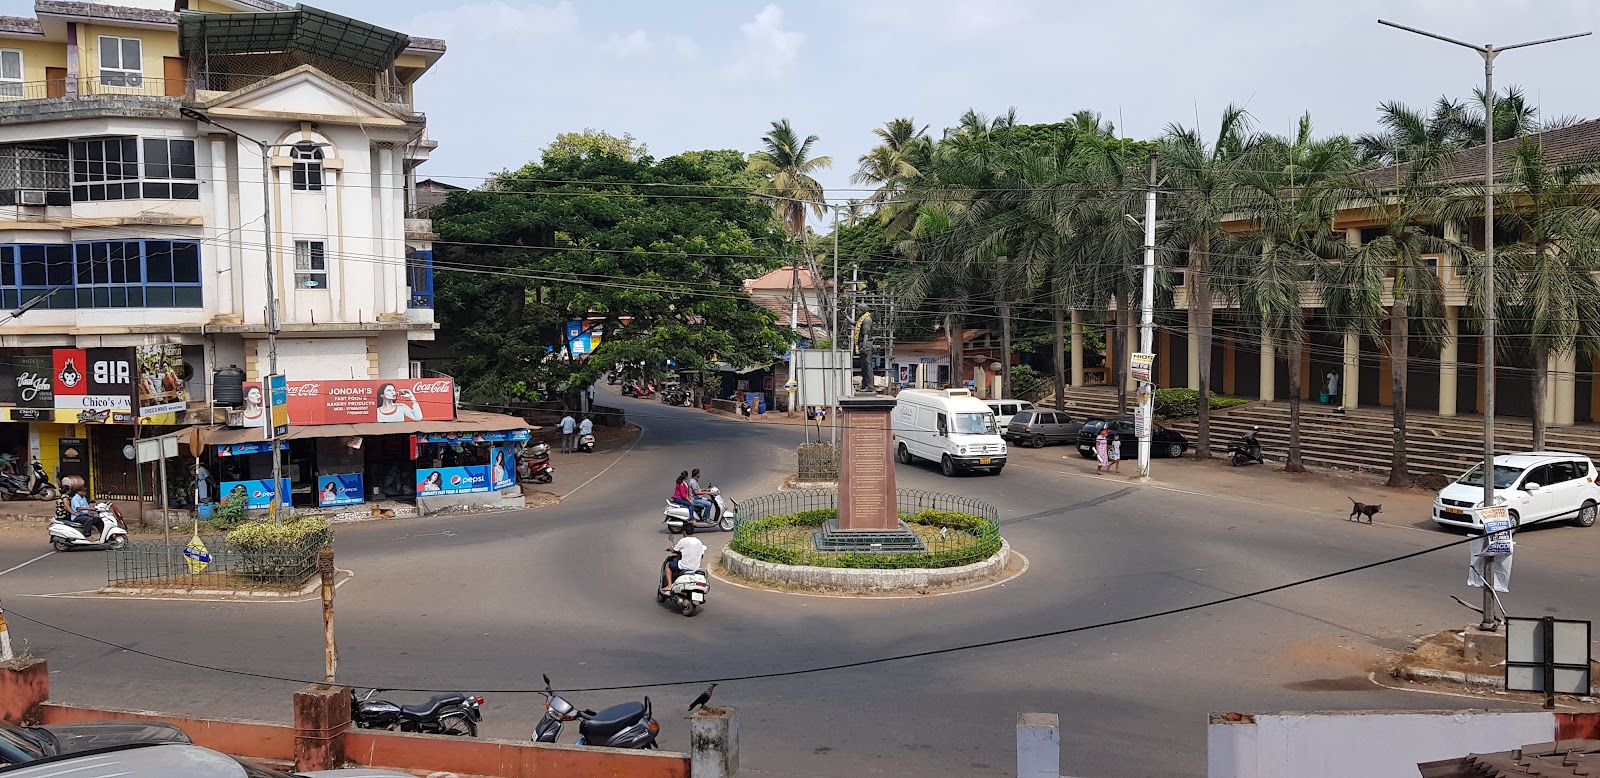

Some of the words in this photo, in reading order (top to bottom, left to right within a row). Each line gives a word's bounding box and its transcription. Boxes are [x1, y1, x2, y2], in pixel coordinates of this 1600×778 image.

[93, 360, 130, 384] BIR
[286, 383, 321, 397] oca-Cola
[328, 387, 373, 395] JONOAH'S
[413, 380, 452, 394] Coca-Cola
[82, 396, 115, 407] Chico's
[462, 475, 485, 484] pepsi
